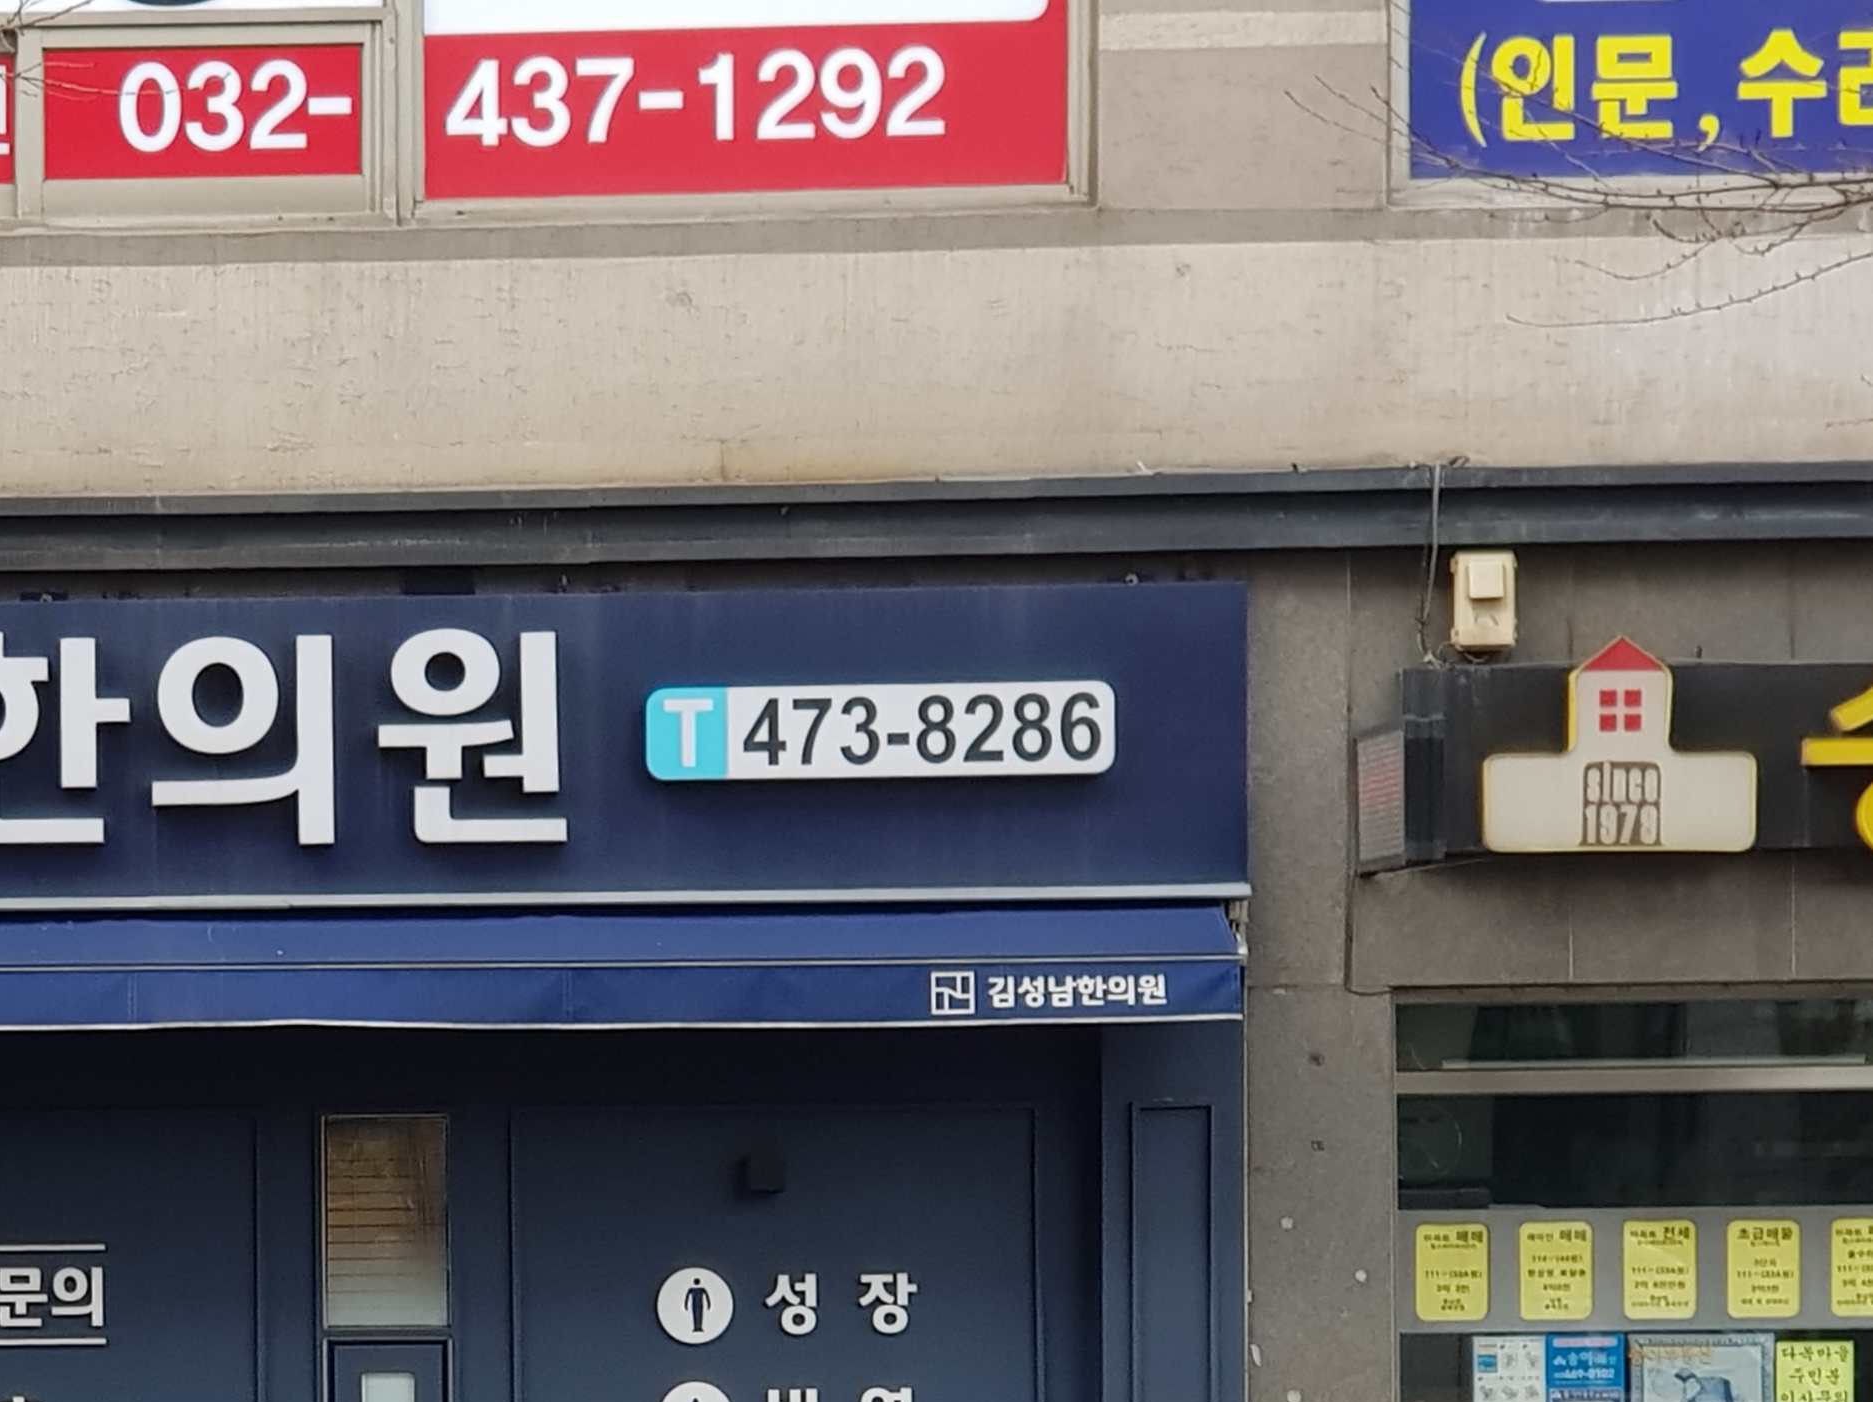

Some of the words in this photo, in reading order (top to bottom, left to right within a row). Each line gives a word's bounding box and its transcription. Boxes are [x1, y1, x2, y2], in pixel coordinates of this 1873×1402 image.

[120, 60, 353, 152] 032-
[445, 46, 948, 147] 437-1292
[661, 696, 715, 768] T
[742, 689, 1103, 768] 473-8286
[1585, 804, 1659, 845] 1979
[987, 973, 1168, 1009] 김성남한의원
